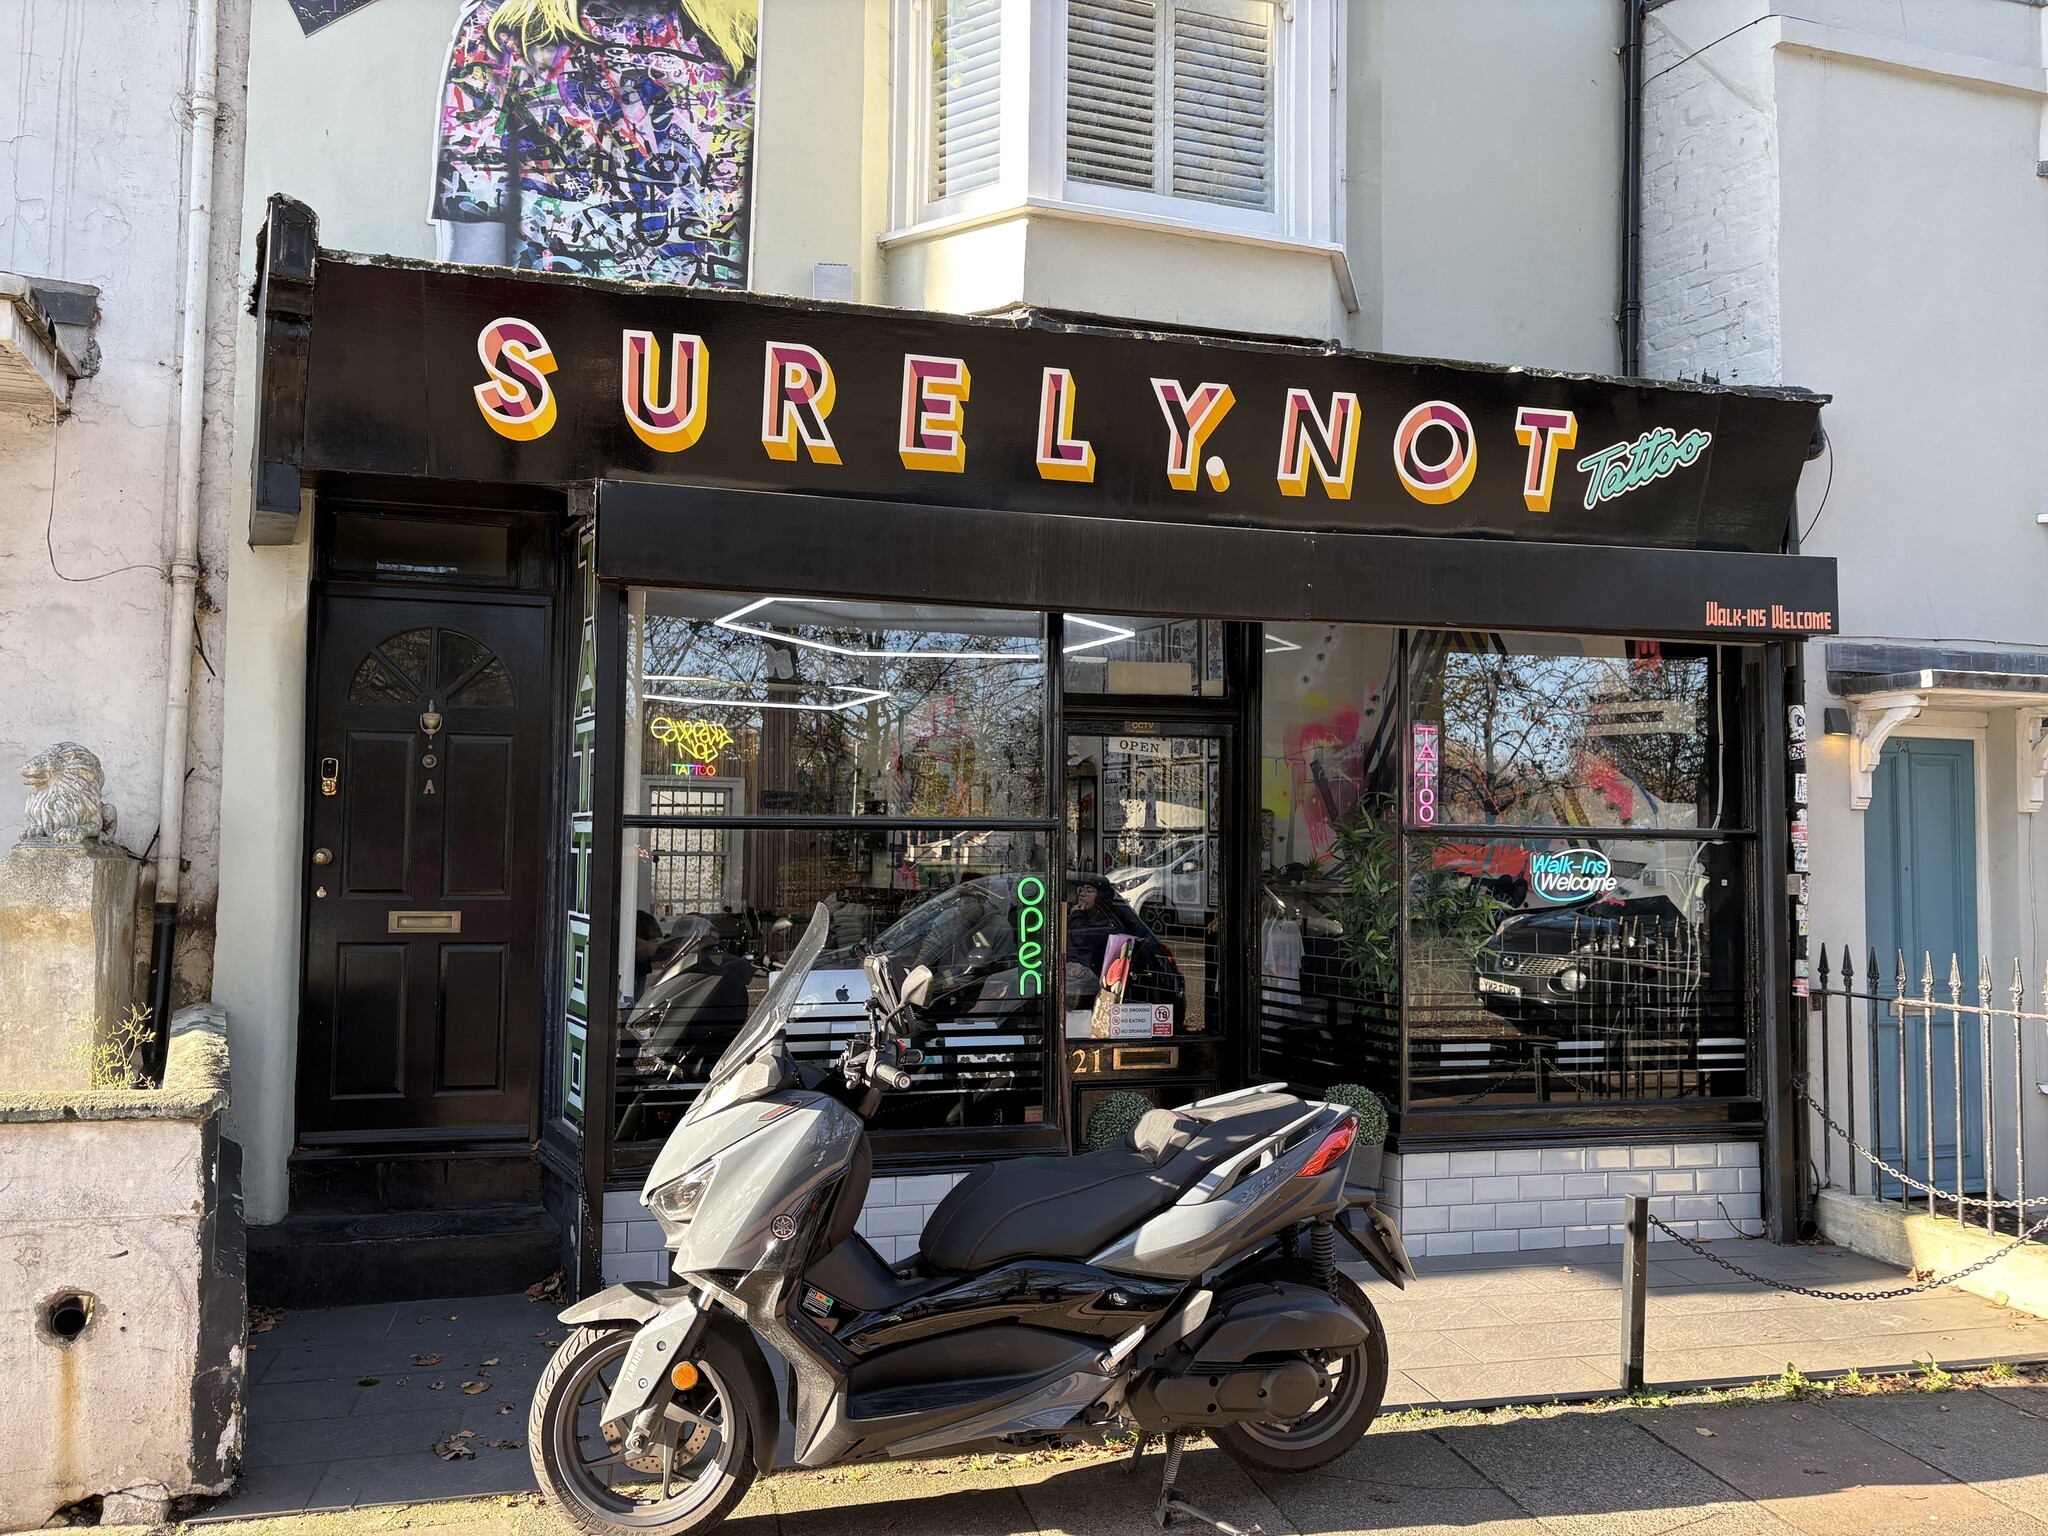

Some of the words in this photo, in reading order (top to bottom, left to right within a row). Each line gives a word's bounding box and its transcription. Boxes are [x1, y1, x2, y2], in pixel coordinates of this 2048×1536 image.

[1577, 426, 1713, 510] Tattoo
[1771, 605, 1832, 630] WELCOME
[1119, 740, 1160, 754] OPEN
[671, 764, 717, 776] TATTOO
[1416, 727, 1437, 823] TATTOO
[422, 779, 436, 795] A
[1531, 854, 1608, 875] Walk-Ins
[1540, 871, 1618, 893] Welcome
[1072, 1049, 1102, 1074] 21
[624, 1347, 645, 1382] YAMAHA
